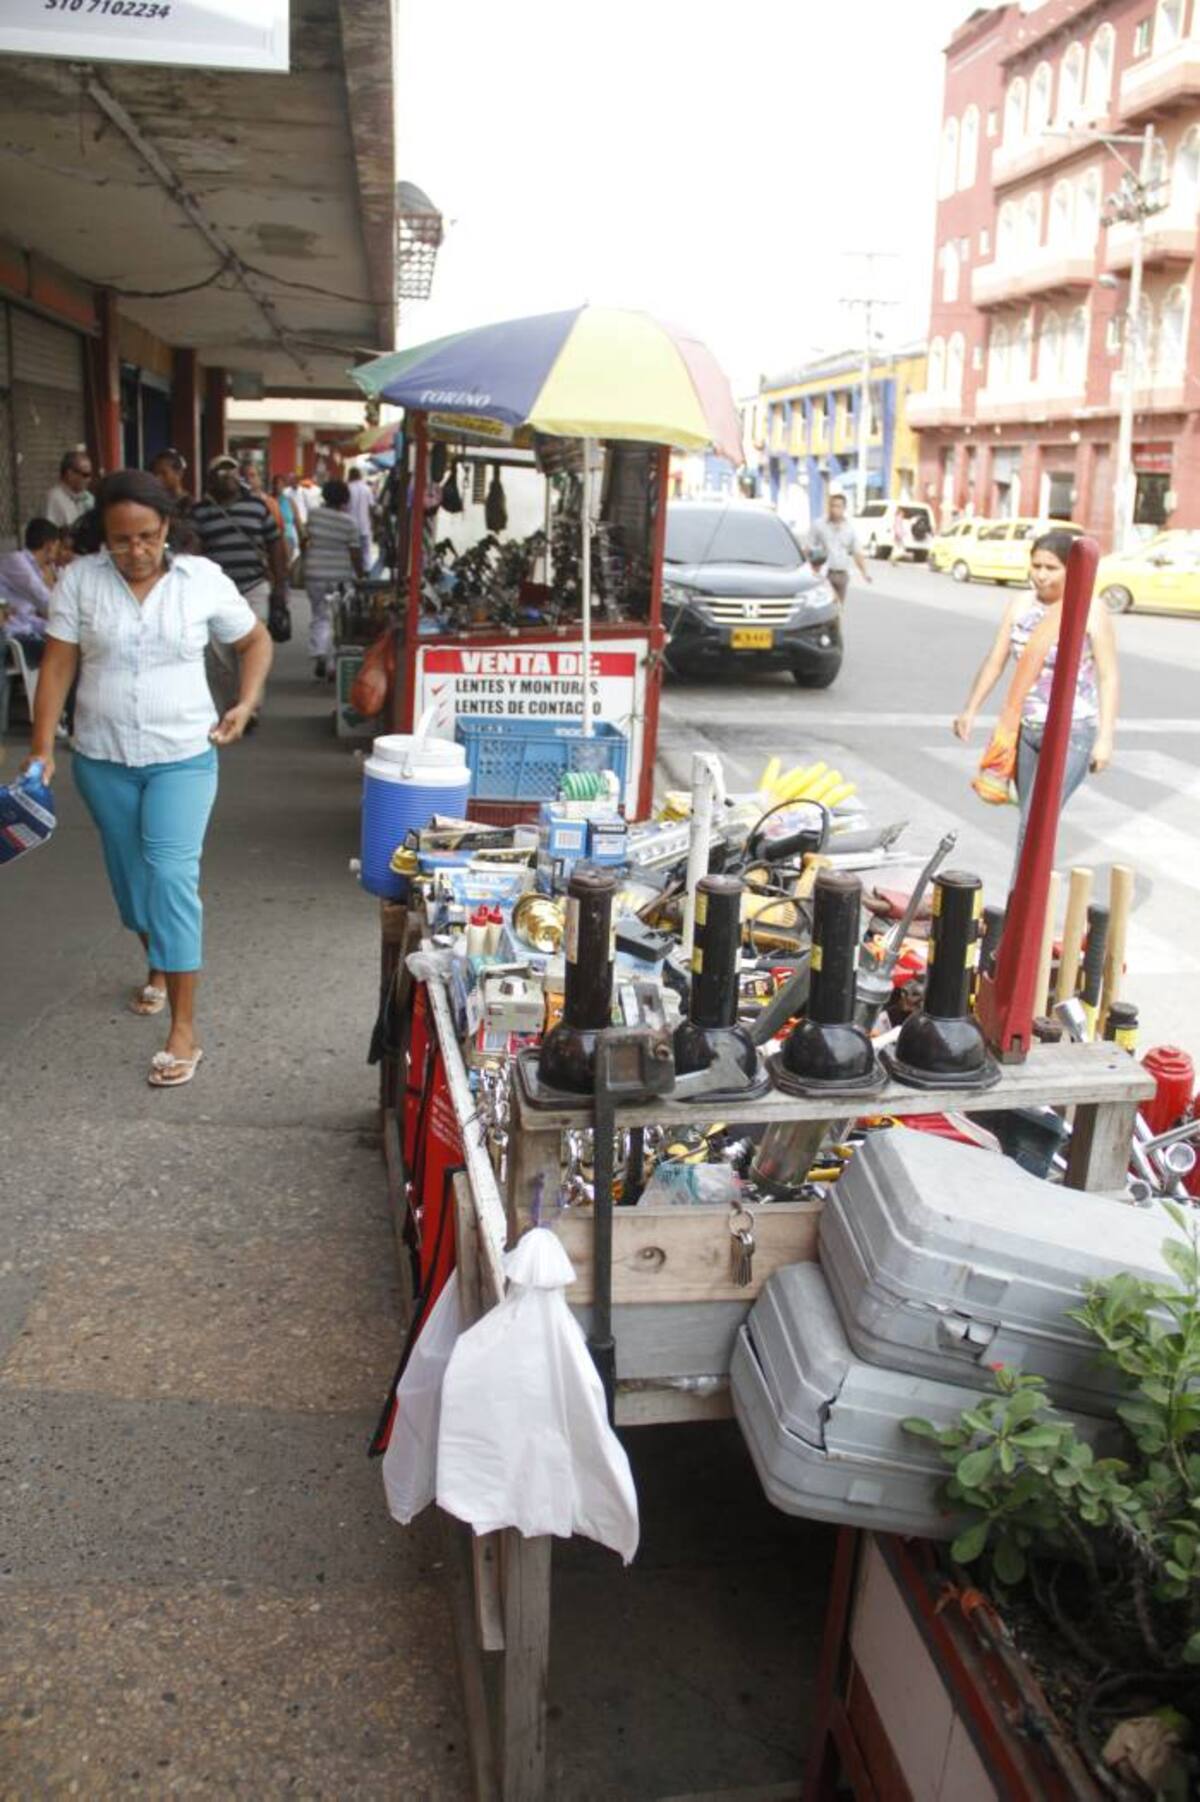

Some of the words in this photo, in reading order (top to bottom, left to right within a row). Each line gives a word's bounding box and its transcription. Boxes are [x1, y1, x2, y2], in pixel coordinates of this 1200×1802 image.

[87, 0, 170, 19] 7102234
[461, 651, 552, 674] VENTA
[455, 678, 504, 694] LENTES
[508, 679, 516, 693] Y
[455, 699, 504, 715] LENTES
[508, 700, 526, 715] DE
[530, 701, 601, 716] CONTACO
